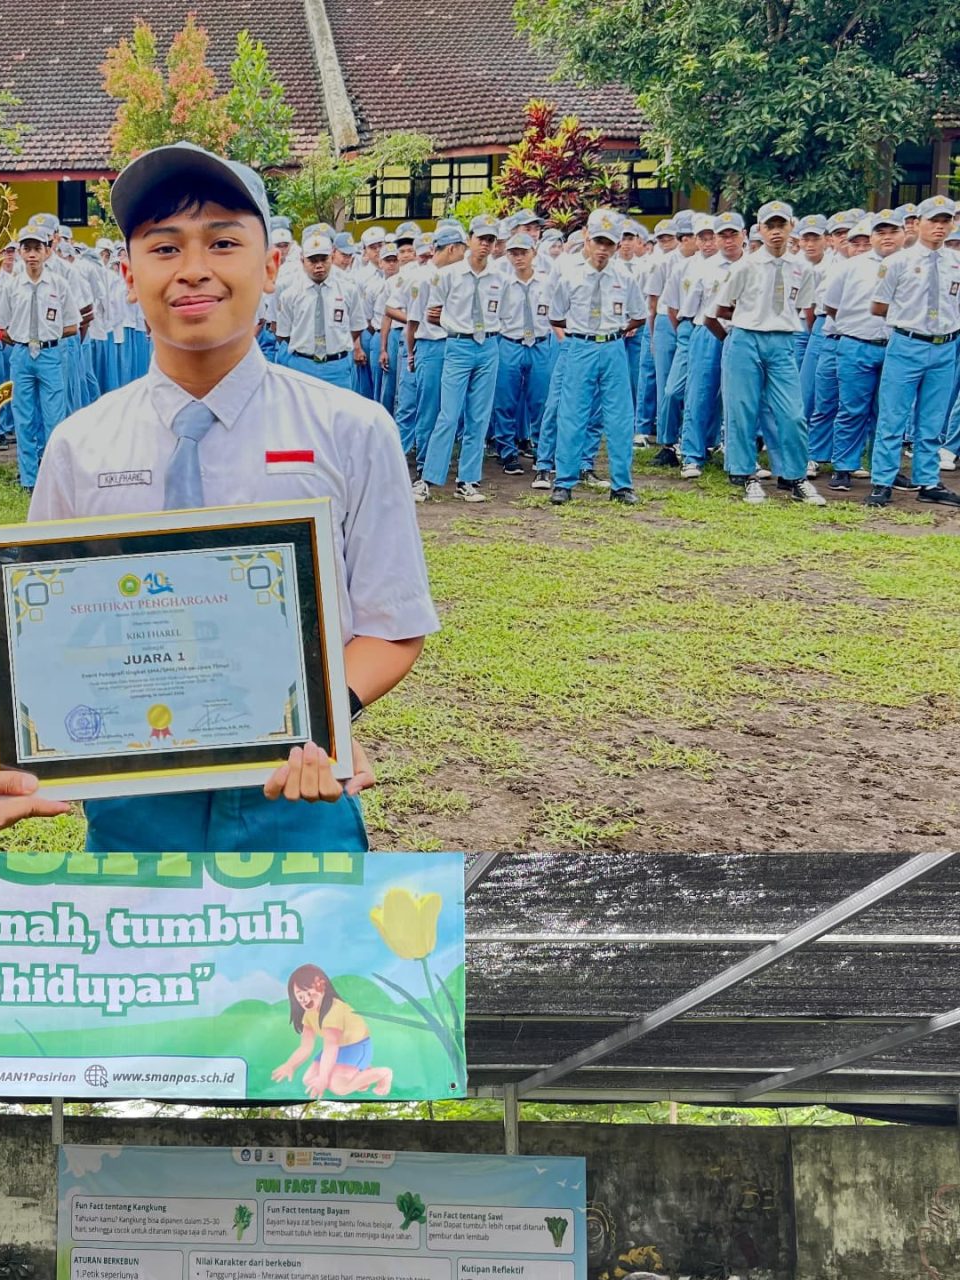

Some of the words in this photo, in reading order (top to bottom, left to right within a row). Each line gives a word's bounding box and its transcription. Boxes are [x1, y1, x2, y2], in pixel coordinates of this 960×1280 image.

[70, 601, 136, 614] SERTIFIKAT
[138, 594, 229, 610] PENGHARGAAN
[123, 653, 172, 665] JUARA
[178, 652, 185, 661] 1
[109, 901, 299, 944] tumbuh
[112, 1071, 235, 1085] www.smanpas.sch.id
[256, 1178, 281, 1193] FUN
[284, 1179, 316, 1194] FACT
[320, 1180, 380, 1196] SAYURAN
[76, 1202, 88, 1210] Fun
[90, 1202, 104, 1210] Fact
[104, 1203, 132, 1212] tentang
[132, 1203, 167, 1212] Kangkung
[267, 1206, 281, 1214] Fun
[282, 1206, 297, 1214] Fact
[298, 1208, 326, 1217] tentang
[326, 1208, 350, 1217] Bayam
[266, 1218, 285, 1227] Bayam
[458, 1212, 486, 1222] tentang
[444, 1222, 462, 1230] Dapat
[505, 1224, 522, 1232] cepat
[428, 1234, 453, 1242] gembur
[74, 1256, 102, 1264] ATURAN
[103, 1257, 140, 1266] BERKEBUN
[196, 1257, 212, 1266] Nilai
[214, 1258, 247, 1266] Karakter
[248, 1258, 263, 1267] dari
[266, 1259, 301, 1268] berkebun
[461, 1264, 490, 1275] Kutipan
[492, 1265, 524, 1274] Reflektif
[101, 1272, 138, 1280] seperlunya
